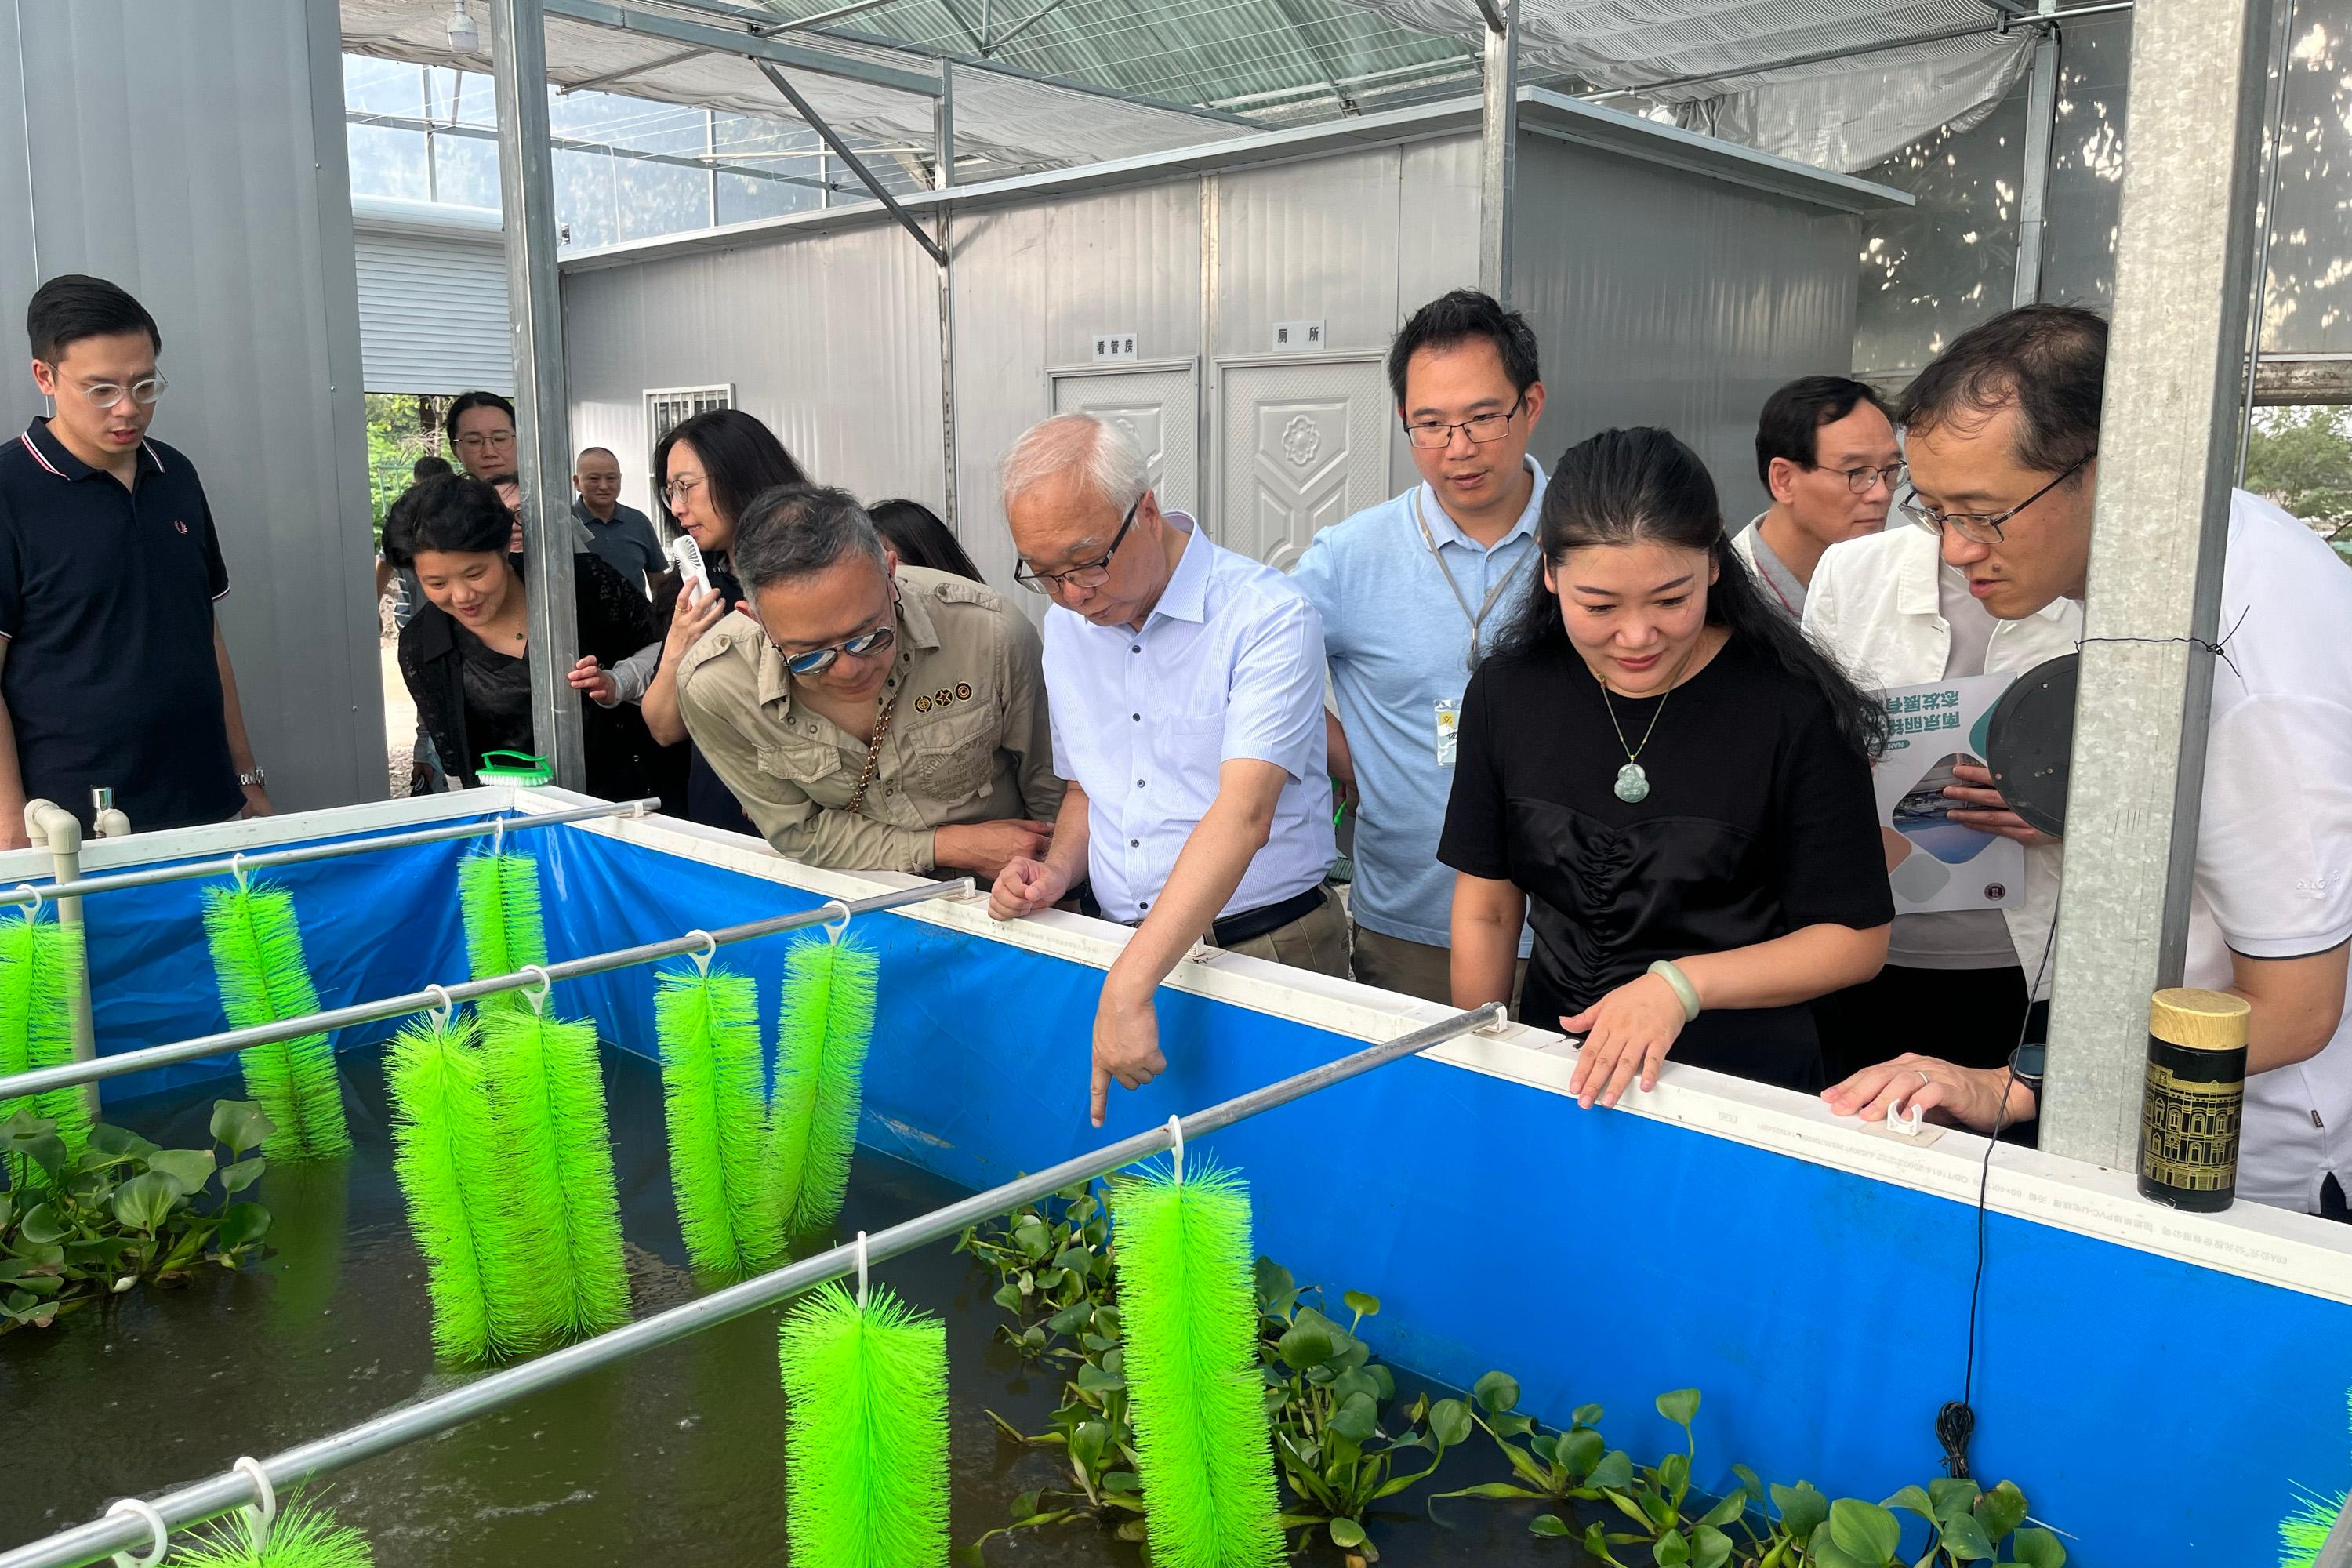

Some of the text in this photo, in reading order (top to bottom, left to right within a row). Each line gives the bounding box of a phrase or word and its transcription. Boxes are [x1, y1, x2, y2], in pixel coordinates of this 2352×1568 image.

[1278, 326, 1319, 343] 厕所
[1097, 339, 1133, 355] 看管房
